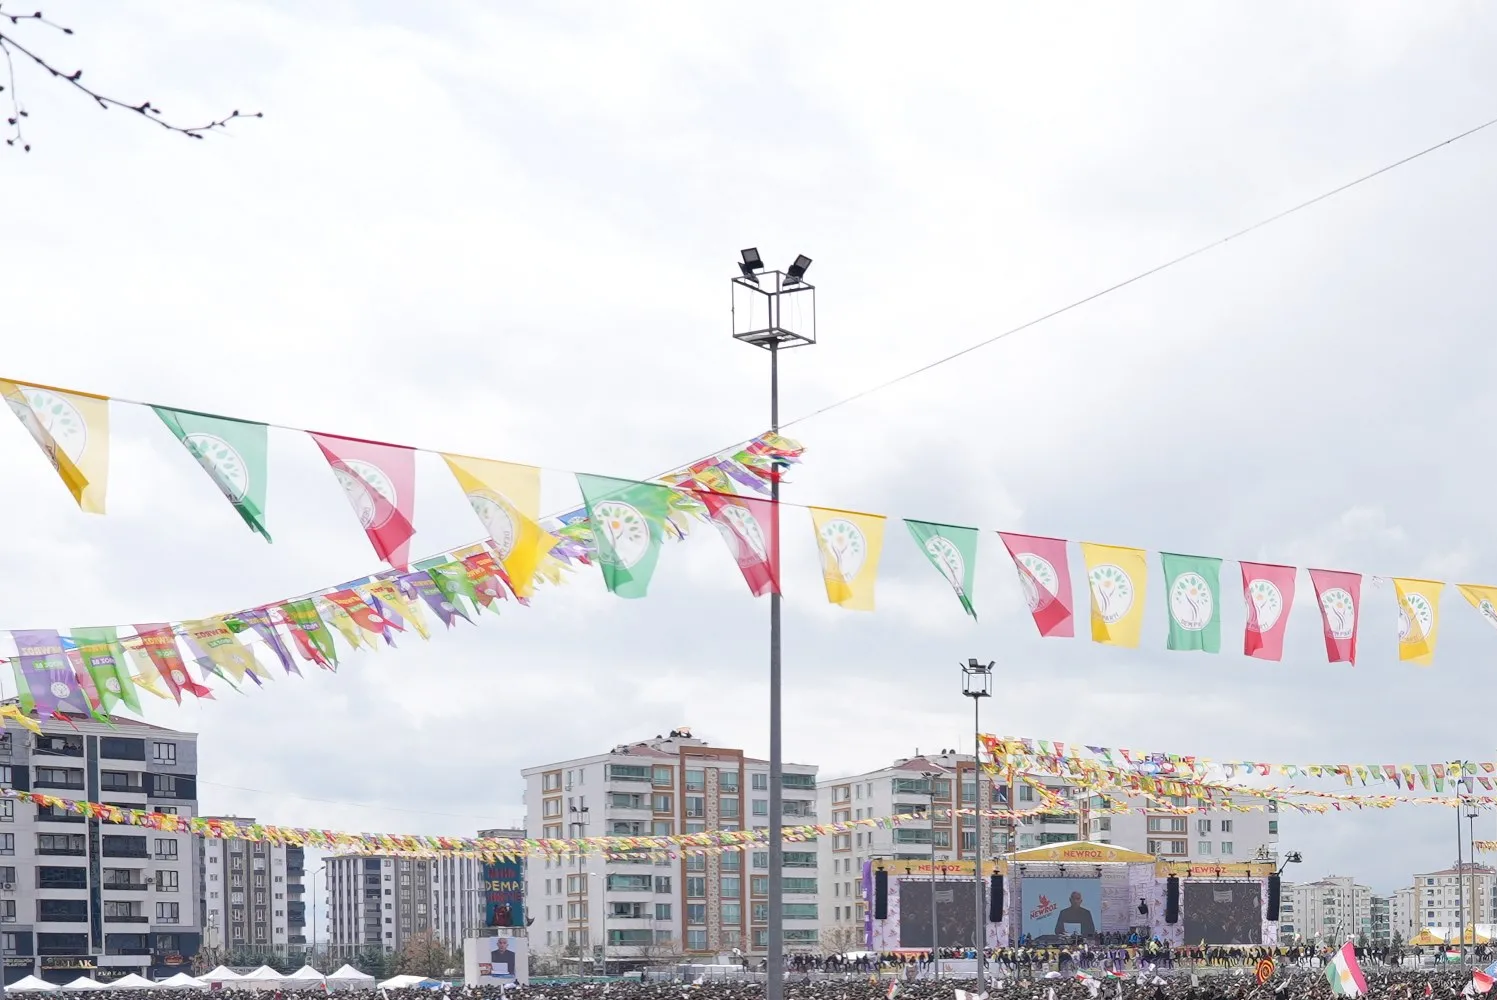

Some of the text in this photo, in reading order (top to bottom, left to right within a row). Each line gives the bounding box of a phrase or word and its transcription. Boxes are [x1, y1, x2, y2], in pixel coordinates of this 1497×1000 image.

[1063, 850, 1102, 858] NEWROZ
[1190, 866, 1228, 874] NEWROZ
[1029, 902, 1057, 919] NEWROZ
